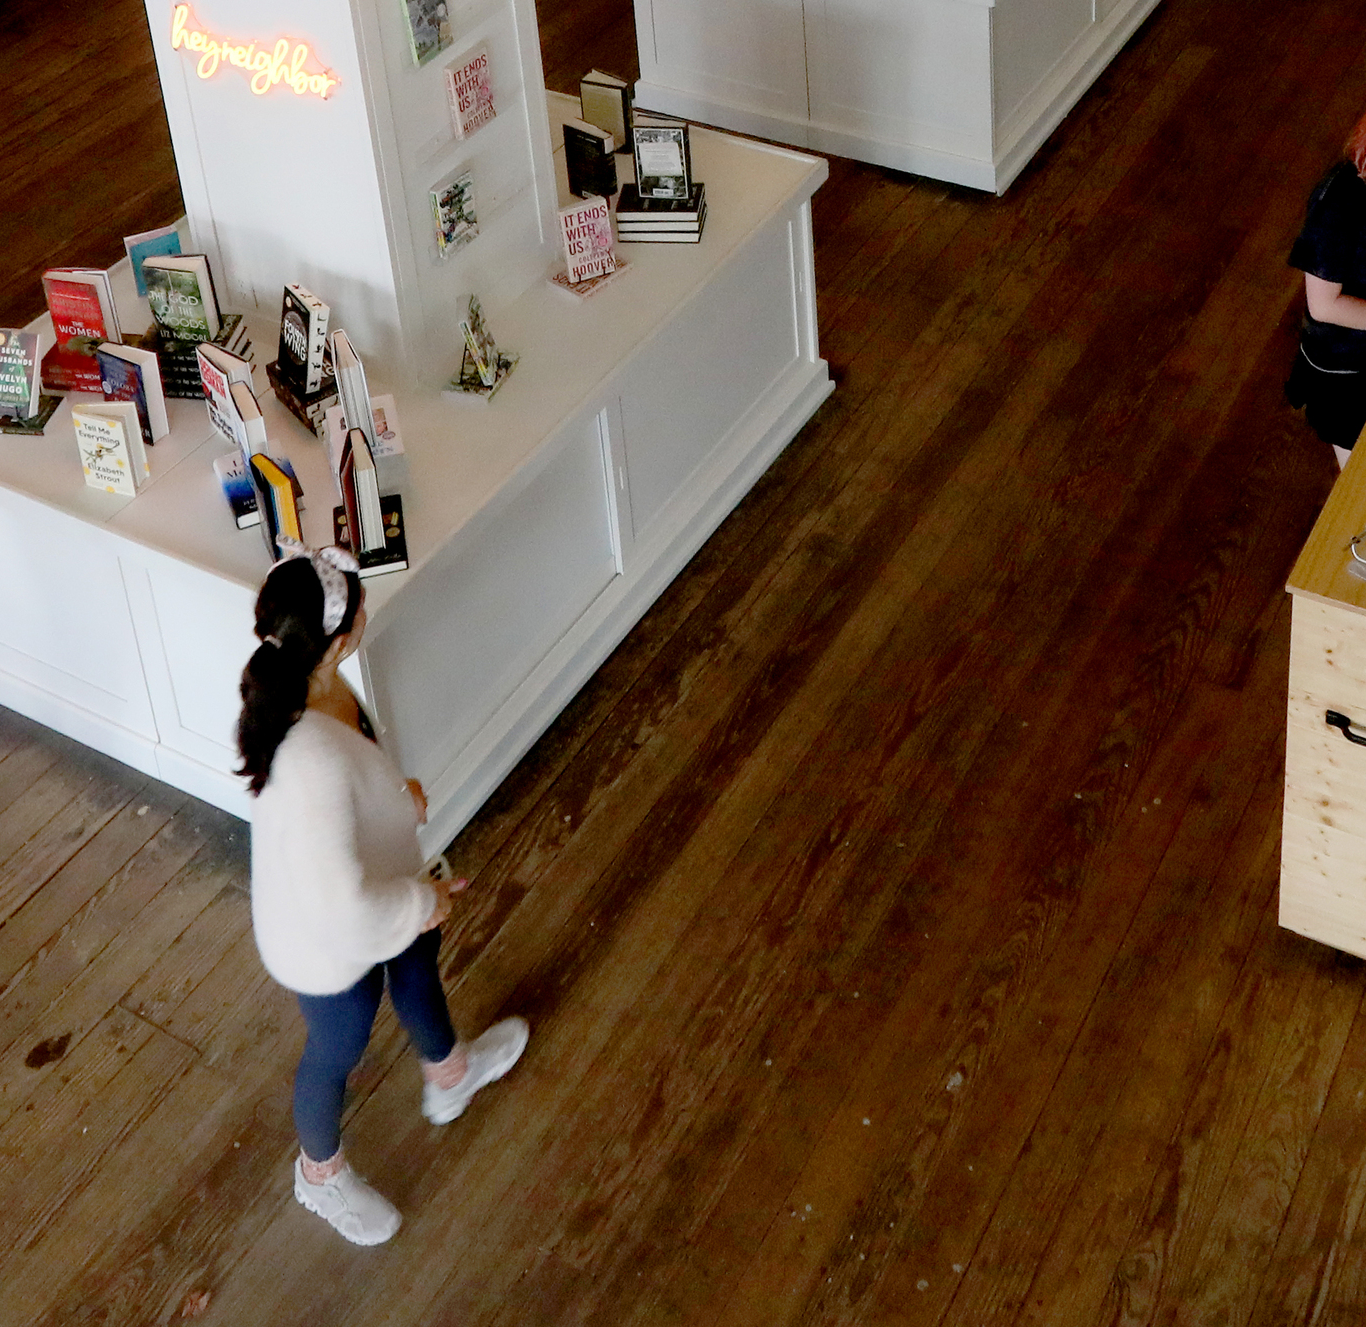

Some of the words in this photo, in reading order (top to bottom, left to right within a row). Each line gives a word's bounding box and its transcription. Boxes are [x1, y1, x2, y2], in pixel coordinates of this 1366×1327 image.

[454, 69, 461, 85] IT
[464, 54, 487, 79] ENDS
[455, 74, 479, 99] WITH
[459, 95, 471, 113] US
[564, 214, 574, 228] IT
[577, 205, 607, 224] ENDS
[566, 223, 596, 242] WITH
[568, 240, 584, 256] US
[572, 257, 615, 278] HOOVER
[150, 290, 165, 303] THE
[168, 293, 199, 307] GOD
[161, 304, 175, 314] OF
[178, 306, 193, 317] THE
[156, 315, 207, 330] WOODS
[58, 324, 101, 338] WOMEN
[159, 329, 171, 339] LIZ
[1, 347, 26, 356] SEVEN
[284, 332, 306, 362] WING
[83, 423, 97, 432] Tell
[98, 426, 111, 435] Me
[78, 429, 120, 447] Everything
[87, 462, 125, 477] Elizabeth
[95, 473, 121, 484] Strout
